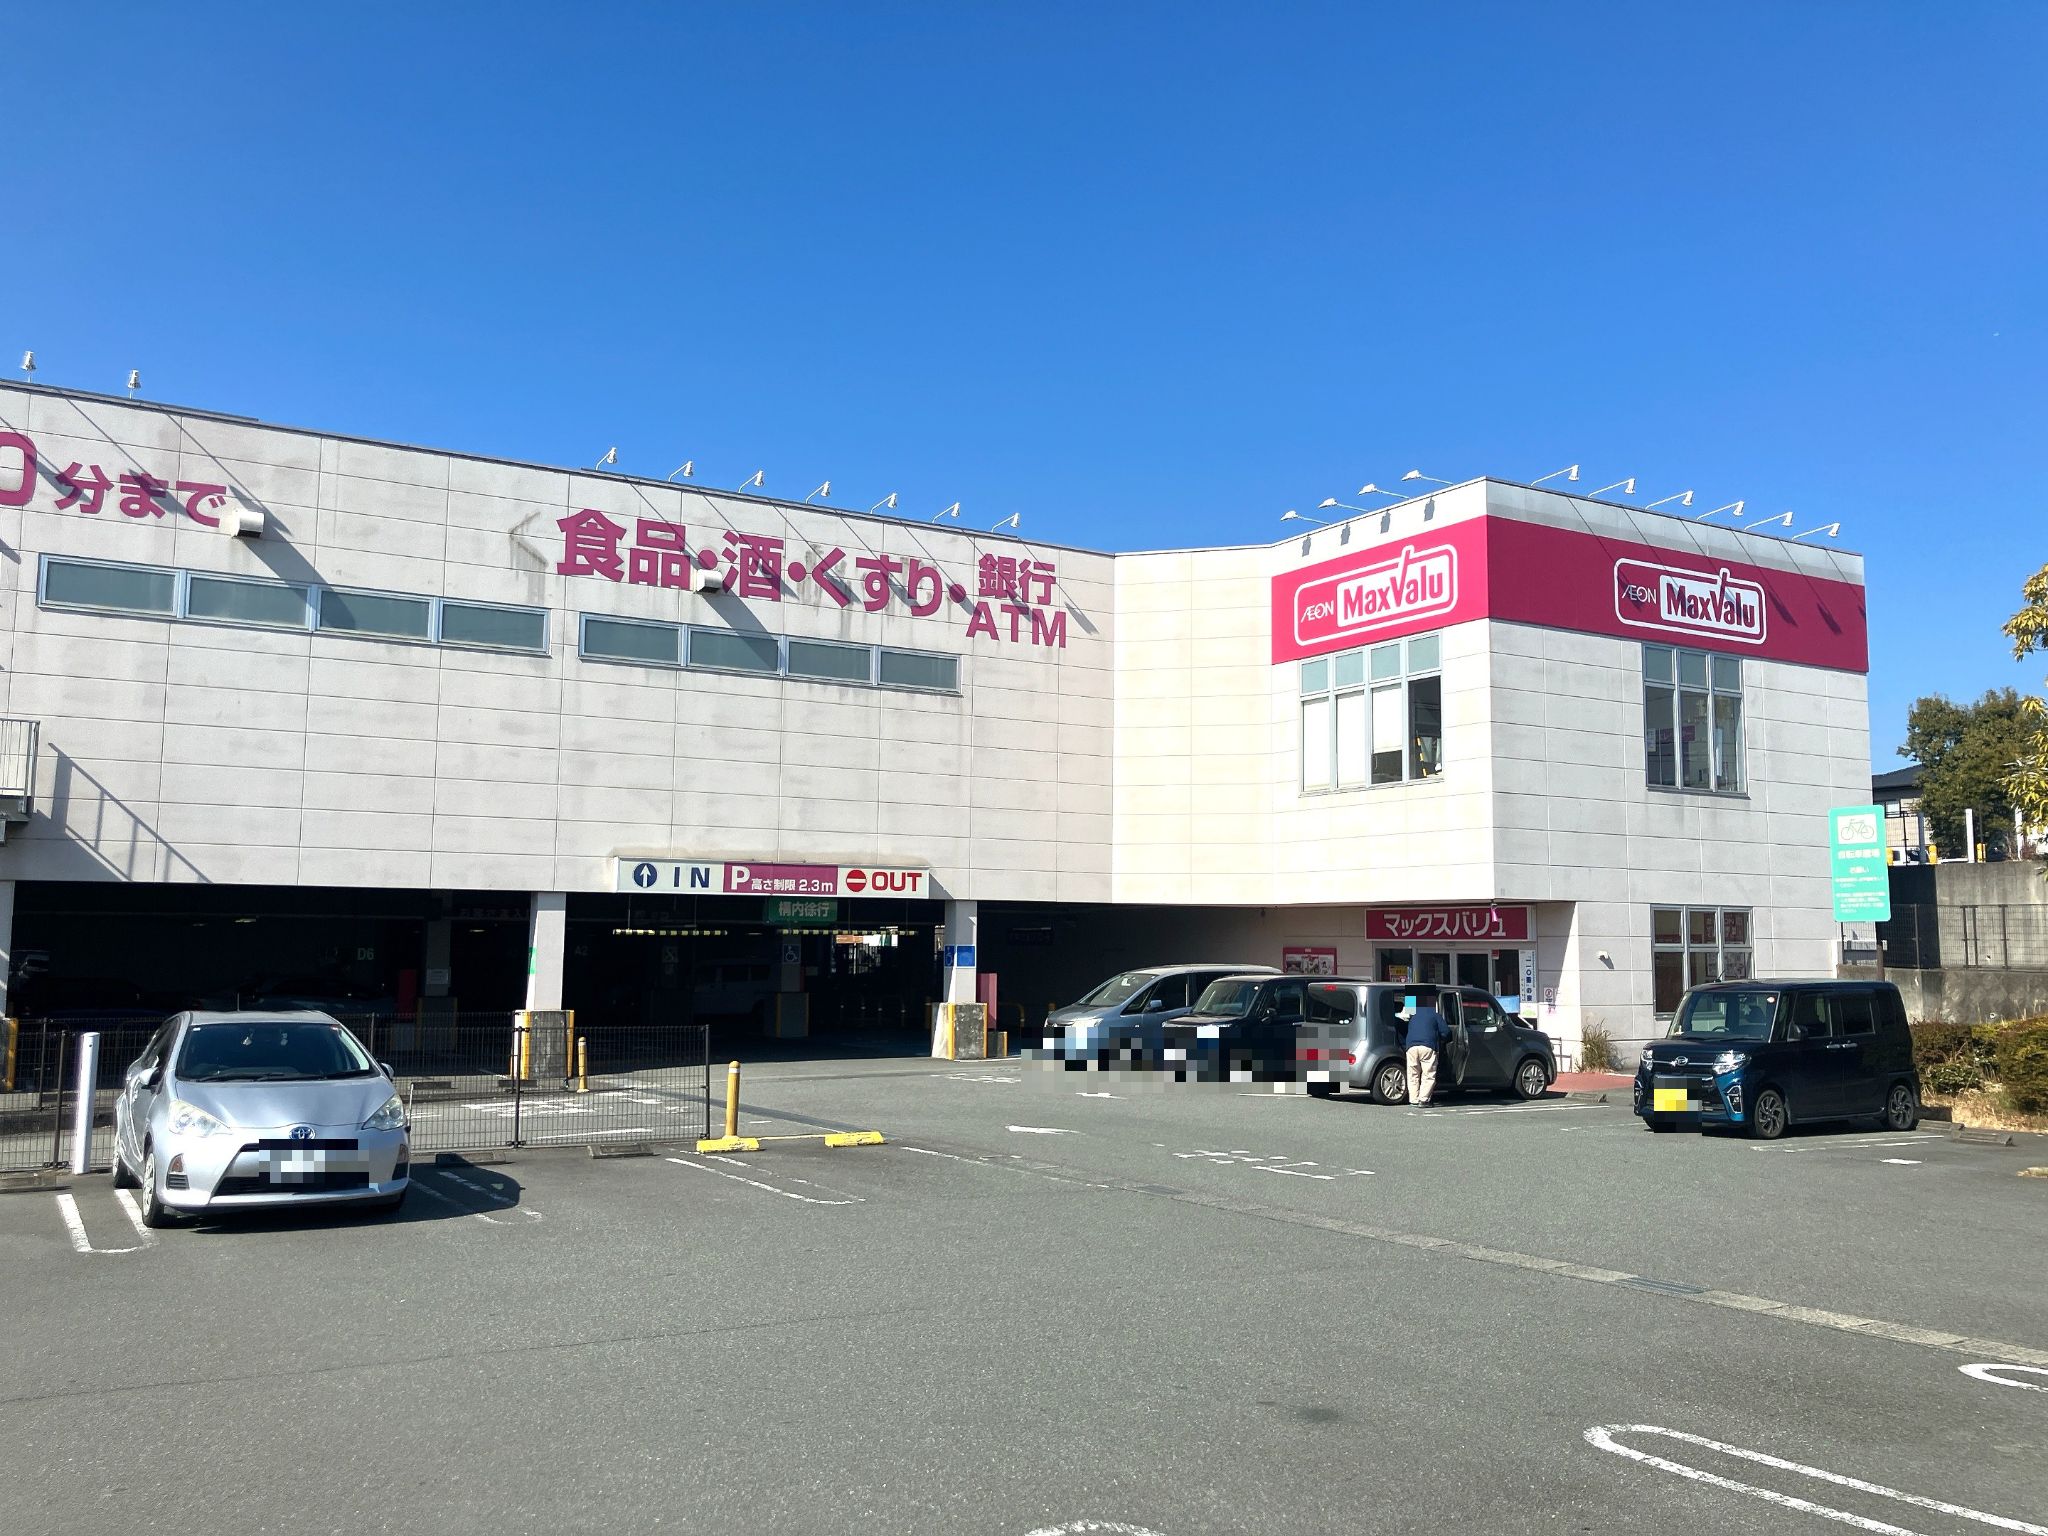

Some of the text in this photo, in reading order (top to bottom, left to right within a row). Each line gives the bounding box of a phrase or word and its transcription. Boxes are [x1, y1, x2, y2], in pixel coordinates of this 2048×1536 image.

[1344, 550, 1443, 621] MaxValu
[1667, 572, 1755, 628] MaxValu
[965, 601, 1066, 648] ATM
[673, 866, 711, 888] IN
[871, 871, 922, 892] OUT
[1384, 911, 1507, 938] マックスバリュ
